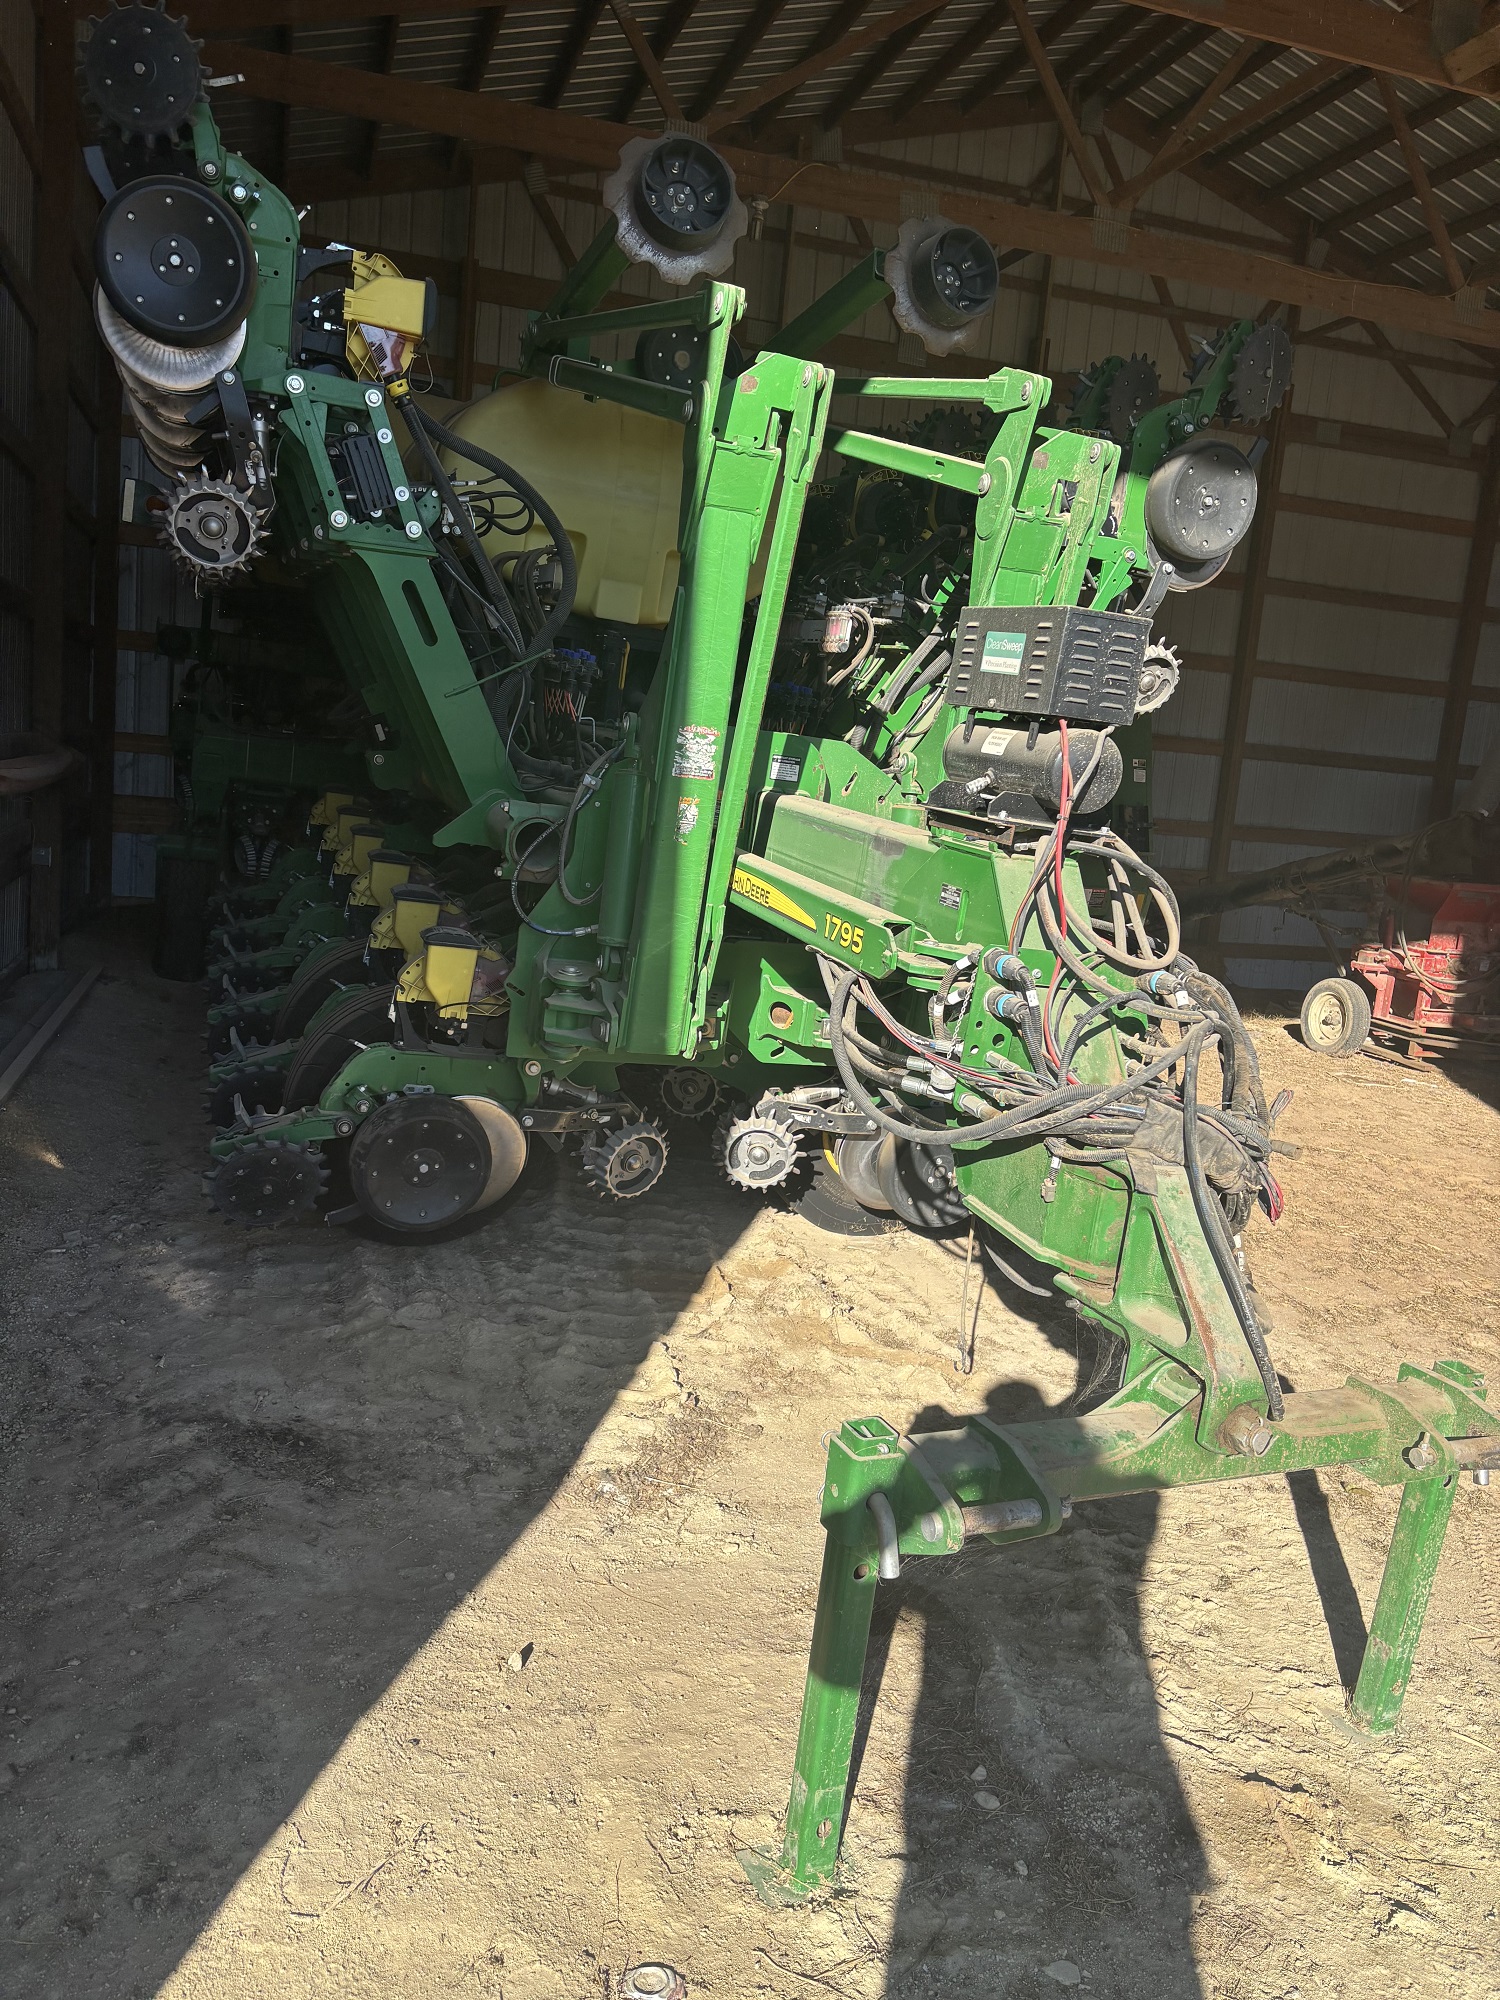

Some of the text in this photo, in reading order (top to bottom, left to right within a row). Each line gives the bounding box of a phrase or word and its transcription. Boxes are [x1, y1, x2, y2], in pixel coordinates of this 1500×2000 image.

[986, 638, 1023, 654] CleanSweep
[733, 874, 771, 905] HN DEERE
[824, 912, 865, 954] 1795
